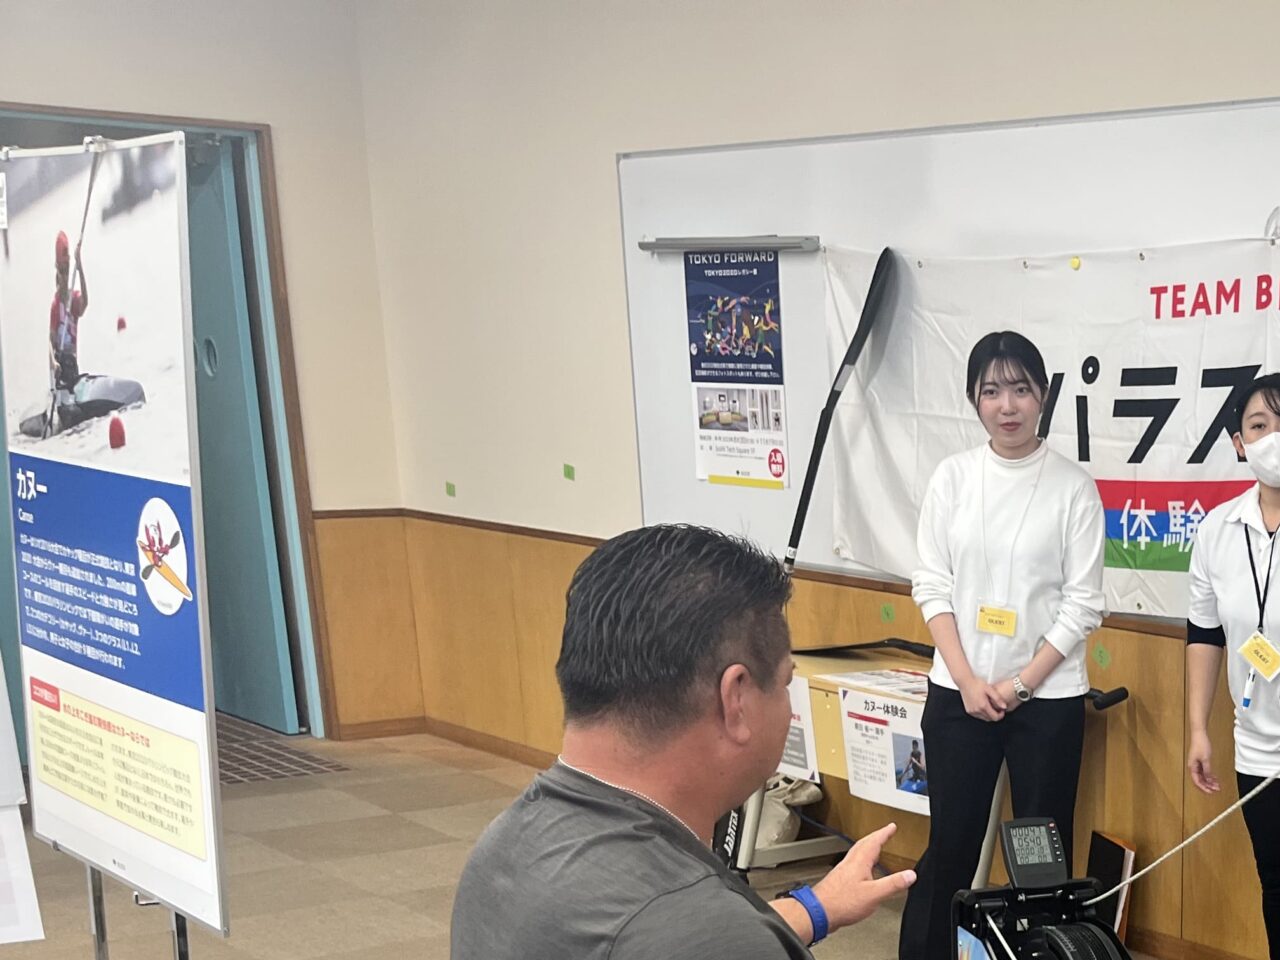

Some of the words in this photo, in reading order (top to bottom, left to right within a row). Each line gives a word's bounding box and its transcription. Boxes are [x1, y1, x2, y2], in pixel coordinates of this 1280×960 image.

[688, 253, 721, 265] TOKYO
[723, 251, 775, 264] FORWARD
[1150, 278, 1241, 320] TEAM
[16, 467, 48, 500] カヌー
[863, 699, 908, 719] カヌー体験会
